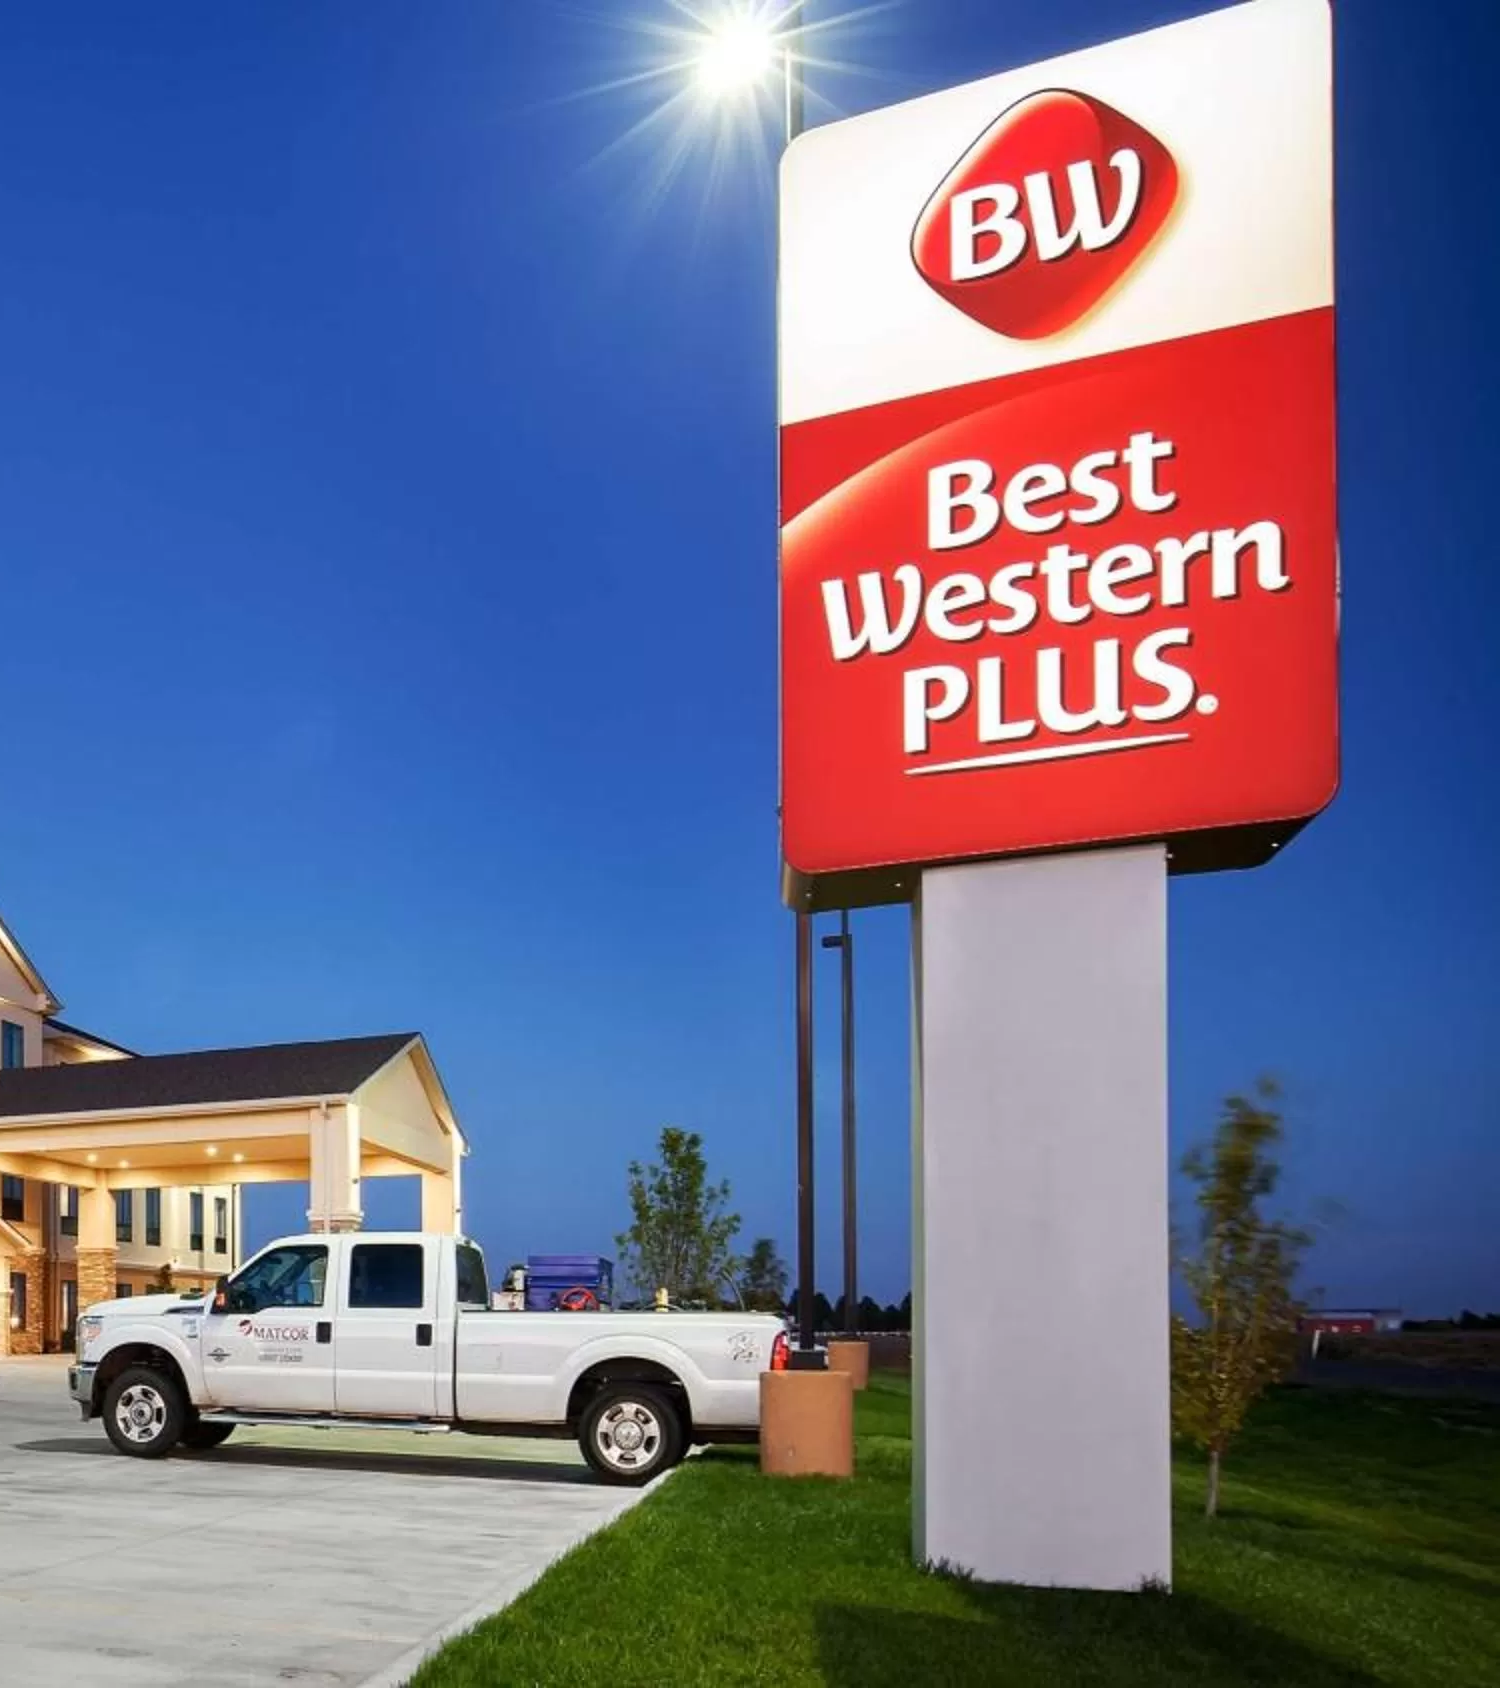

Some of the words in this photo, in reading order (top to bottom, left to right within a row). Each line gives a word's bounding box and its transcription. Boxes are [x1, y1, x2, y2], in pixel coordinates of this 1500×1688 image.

[949, 148, 1141, 282] BW
[927, 430, 1176, 550] Best
[821, 519, 1290, 661] Western
[252, 1326, 309, 1341] MATCOR
